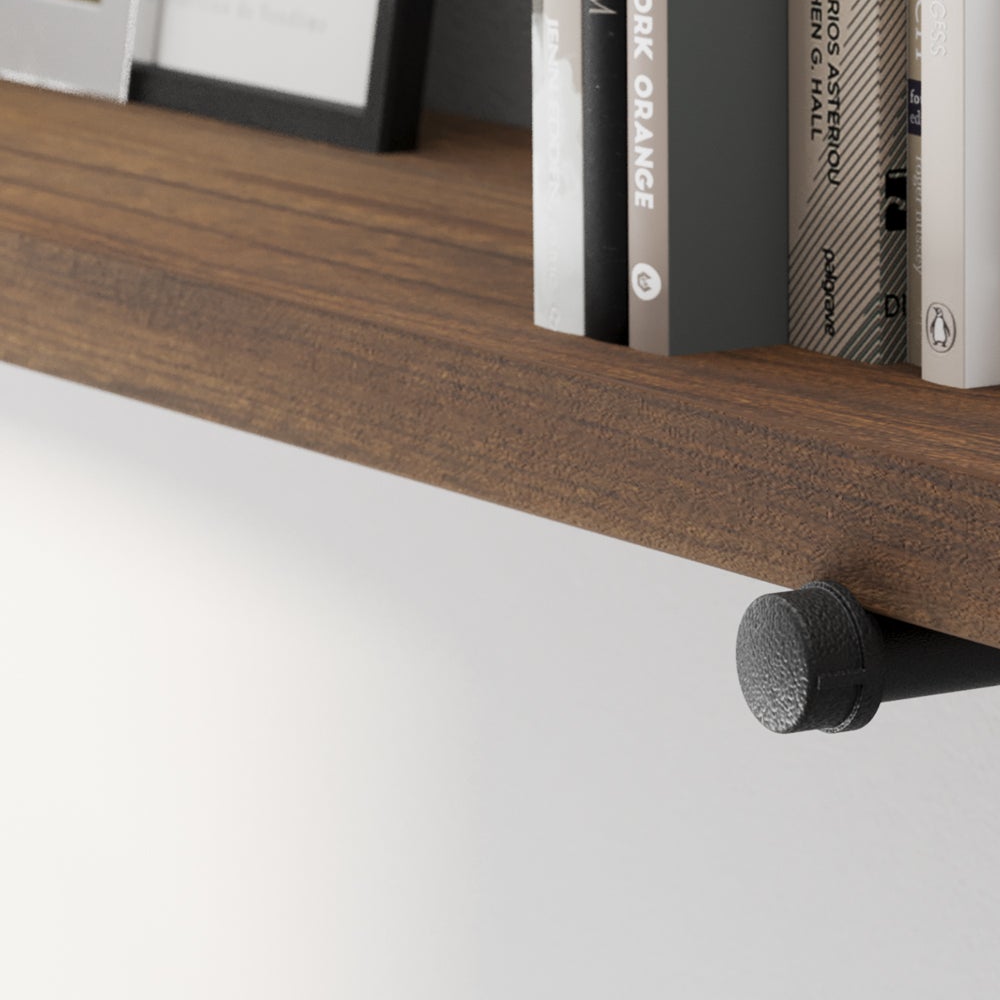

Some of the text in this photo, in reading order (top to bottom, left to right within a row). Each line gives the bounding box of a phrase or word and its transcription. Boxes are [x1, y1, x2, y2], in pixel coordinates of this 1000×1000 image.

[810, 47, 823, 72] G.
[633, 74, 655, 210] ORANGE
[811, 78, 823, 142] HALL
[826, 64, 842, 188] ASTERIOU
[822, 247, 839, 338] palgrave
